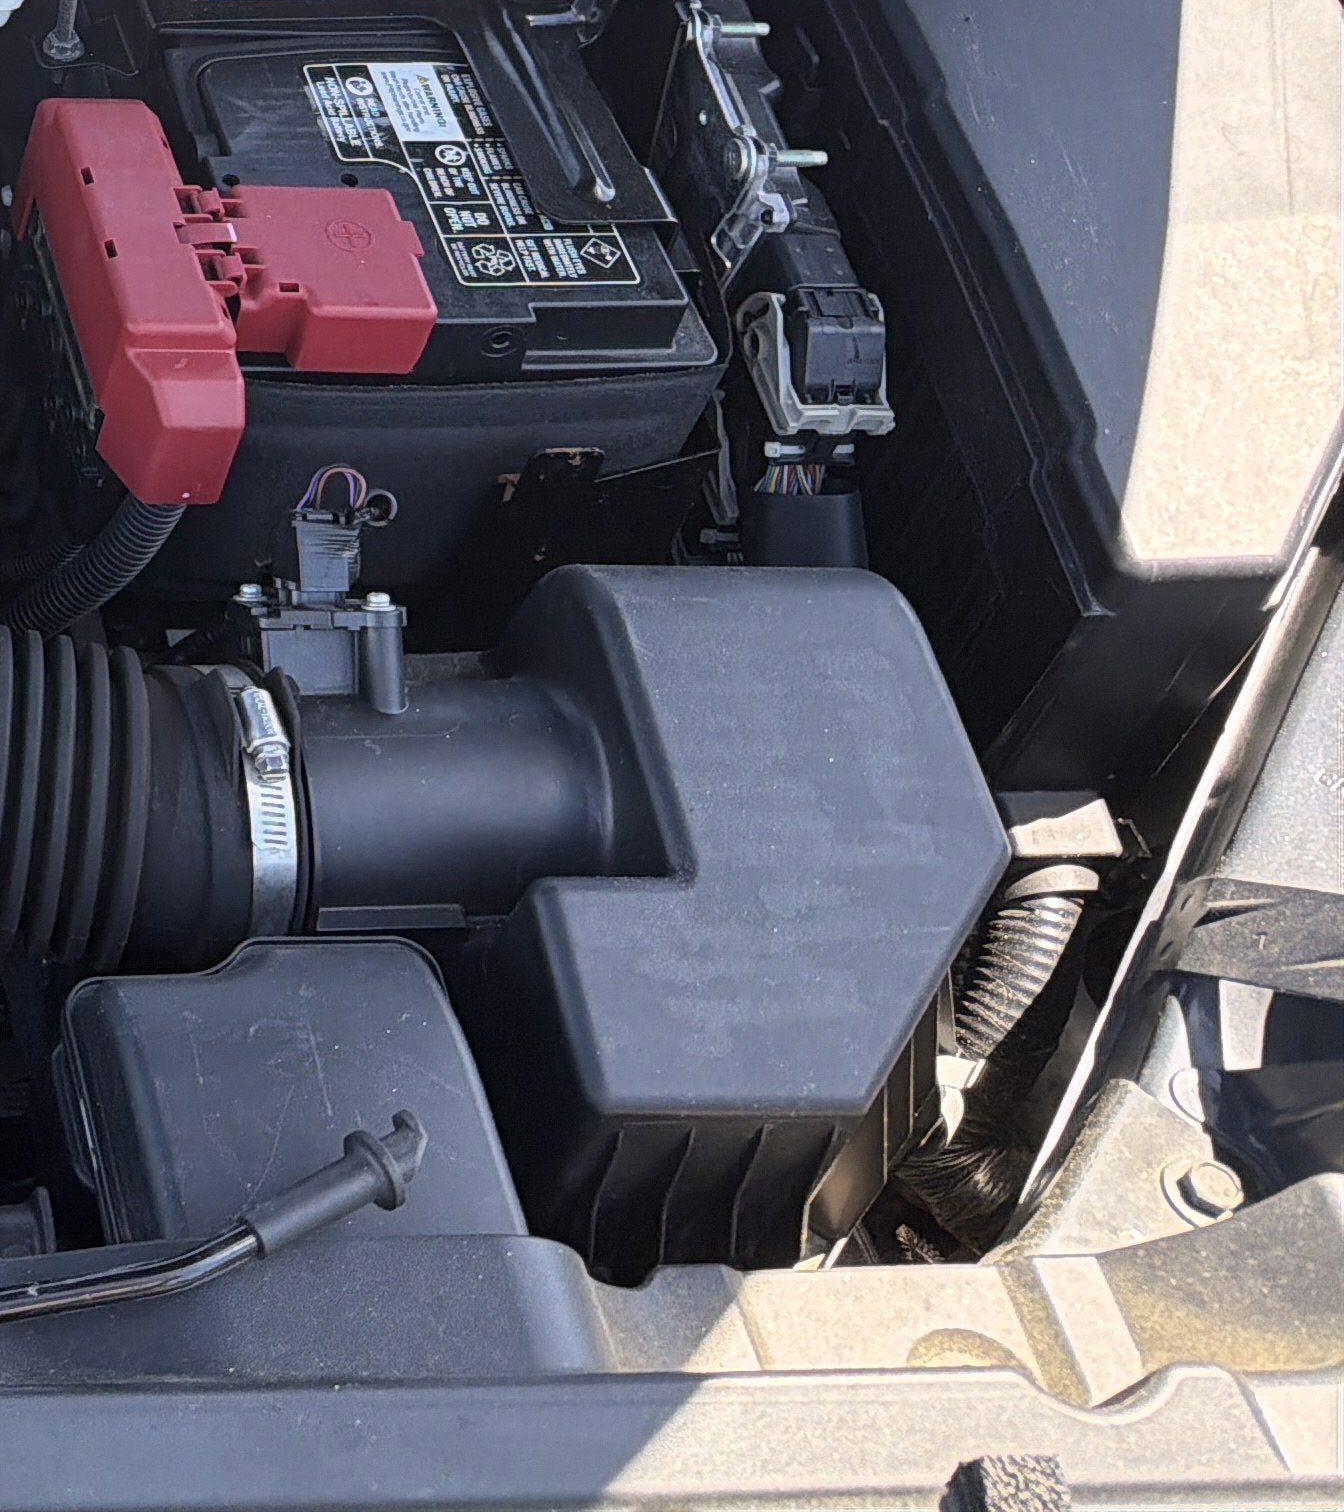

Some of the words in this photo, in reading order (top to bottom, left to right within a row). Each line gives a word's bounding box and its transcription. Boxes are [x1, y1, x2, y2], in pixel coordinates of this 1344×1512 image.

[316, 81, 329, 98] Lead
[461, 74, 482, 105] EXPLOSIVE
[322, 99, 335, 115] Acid
[325, 77, 360, 145] NON-SPILLABLE
[329, 116, 345, 141] Battery
[474, 148, 491, 173] SMOKING
[485, 147, 501, 169] FLAMES
[496, 147, 512, 169] SPARKS
[489, 183, 505, 204] SEVERE
[444, 207, 463, 232] OPEN.
[458, 210, 476, 227] NOT
[474, 212, 489, 225] DO
[553, 238, 576, 277] IMMEDIATELY
[563, 238, 578, 258] FLUSH
[531, 251, 548, 277] MEDICAL
